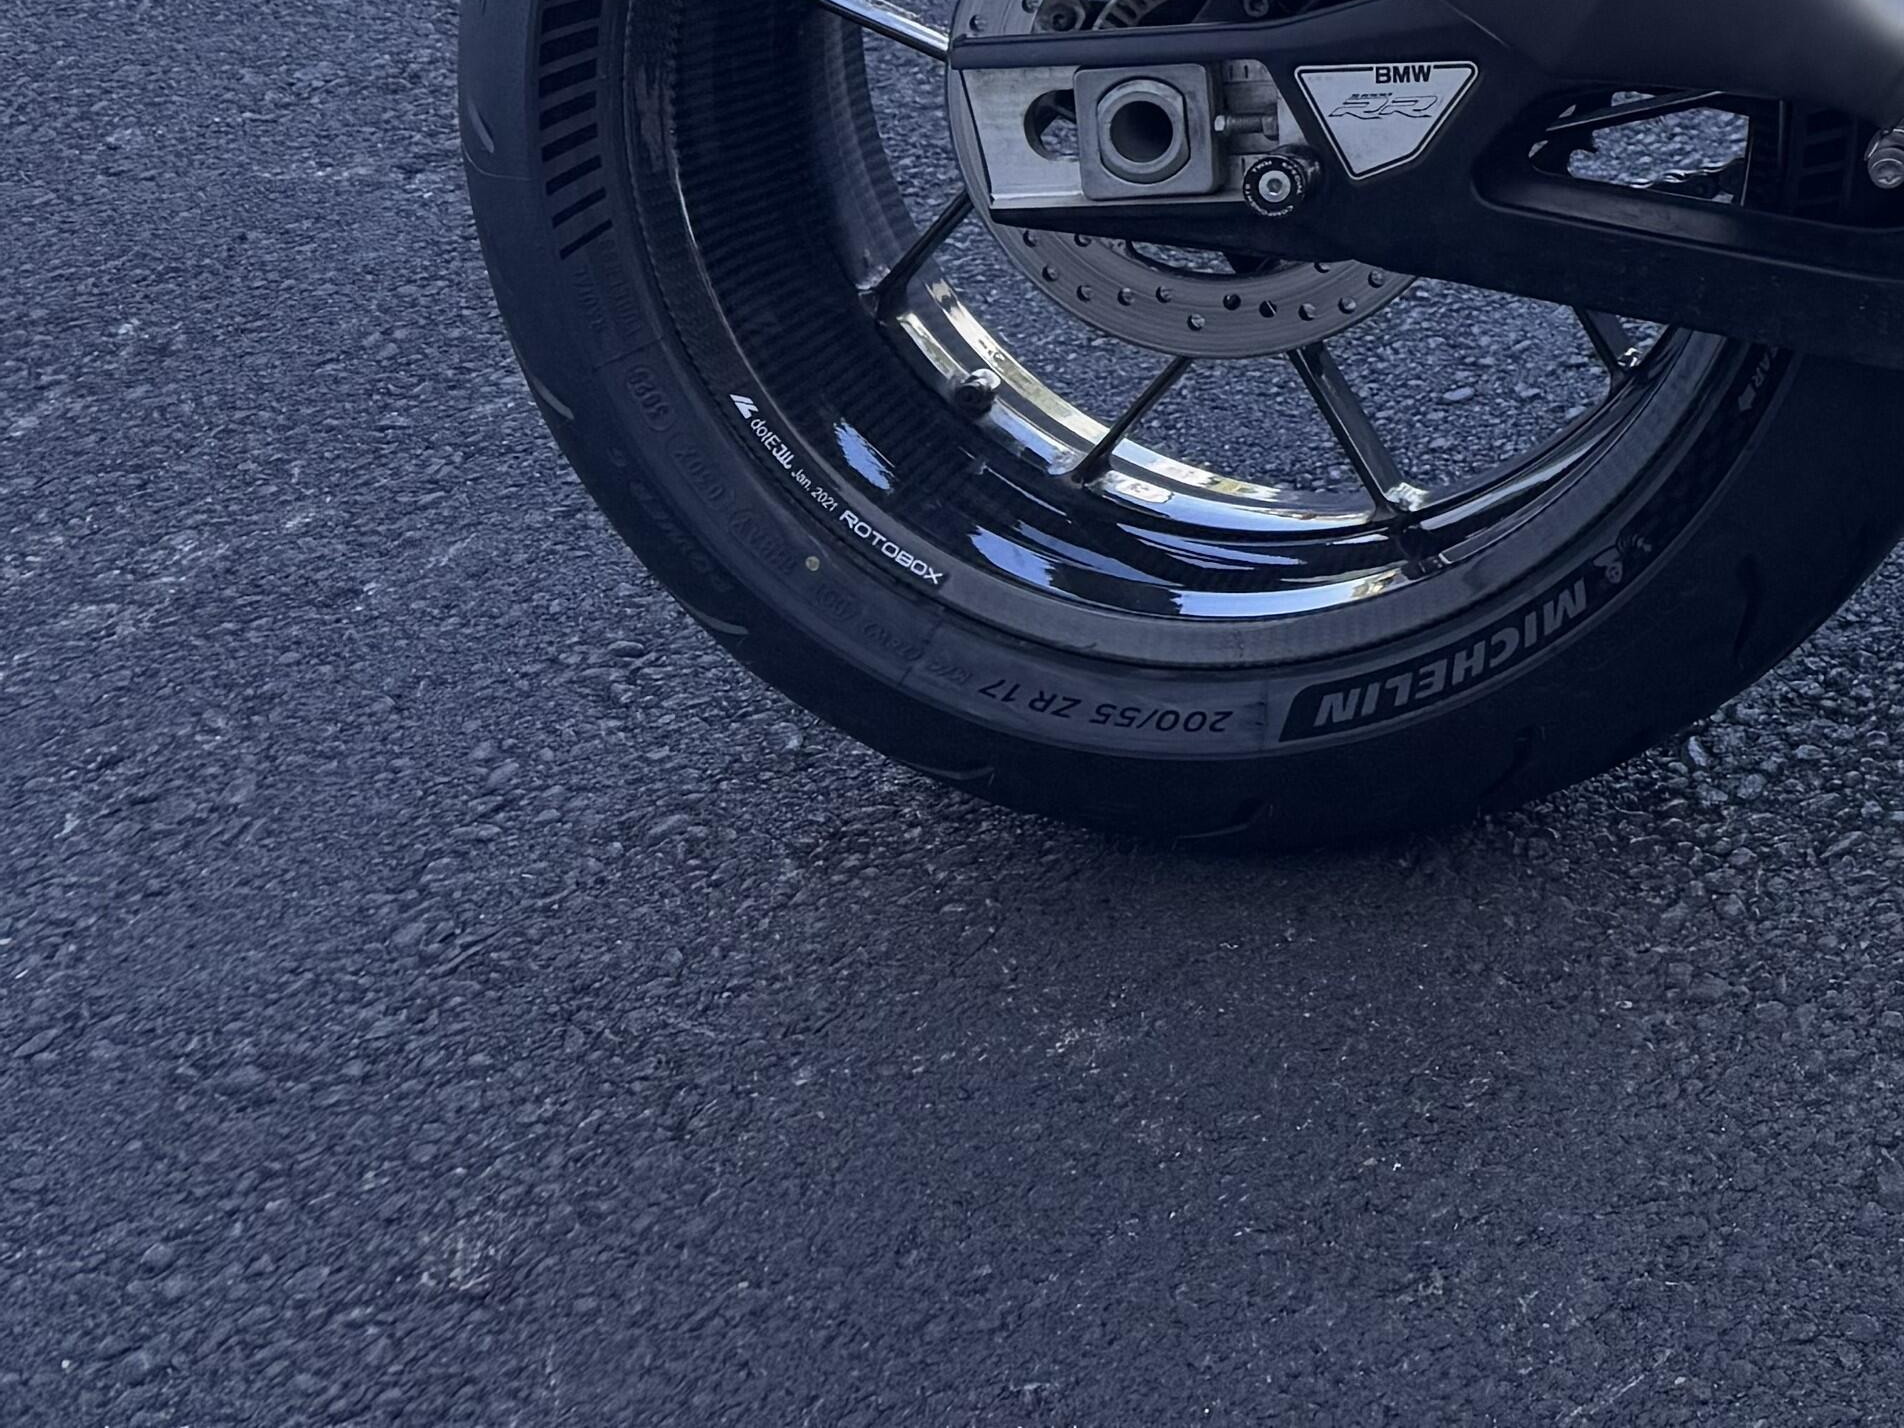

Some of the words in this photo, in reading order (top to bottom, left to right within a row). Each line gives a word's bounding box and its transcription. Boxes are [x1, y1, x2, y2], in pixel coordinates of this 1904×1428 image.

[1375, 65, 1432, 84] BMW
[810, 486, 839, 513] 2021
[838, 509, 944, 586] ROTOBOX
[1312, 575, 1588, 728] MICHELIN
[977, 678, 1022, 703] 17
[1028, 689, 1083, 720] ZR
[1089, 702, 1234, 733] 200/55
